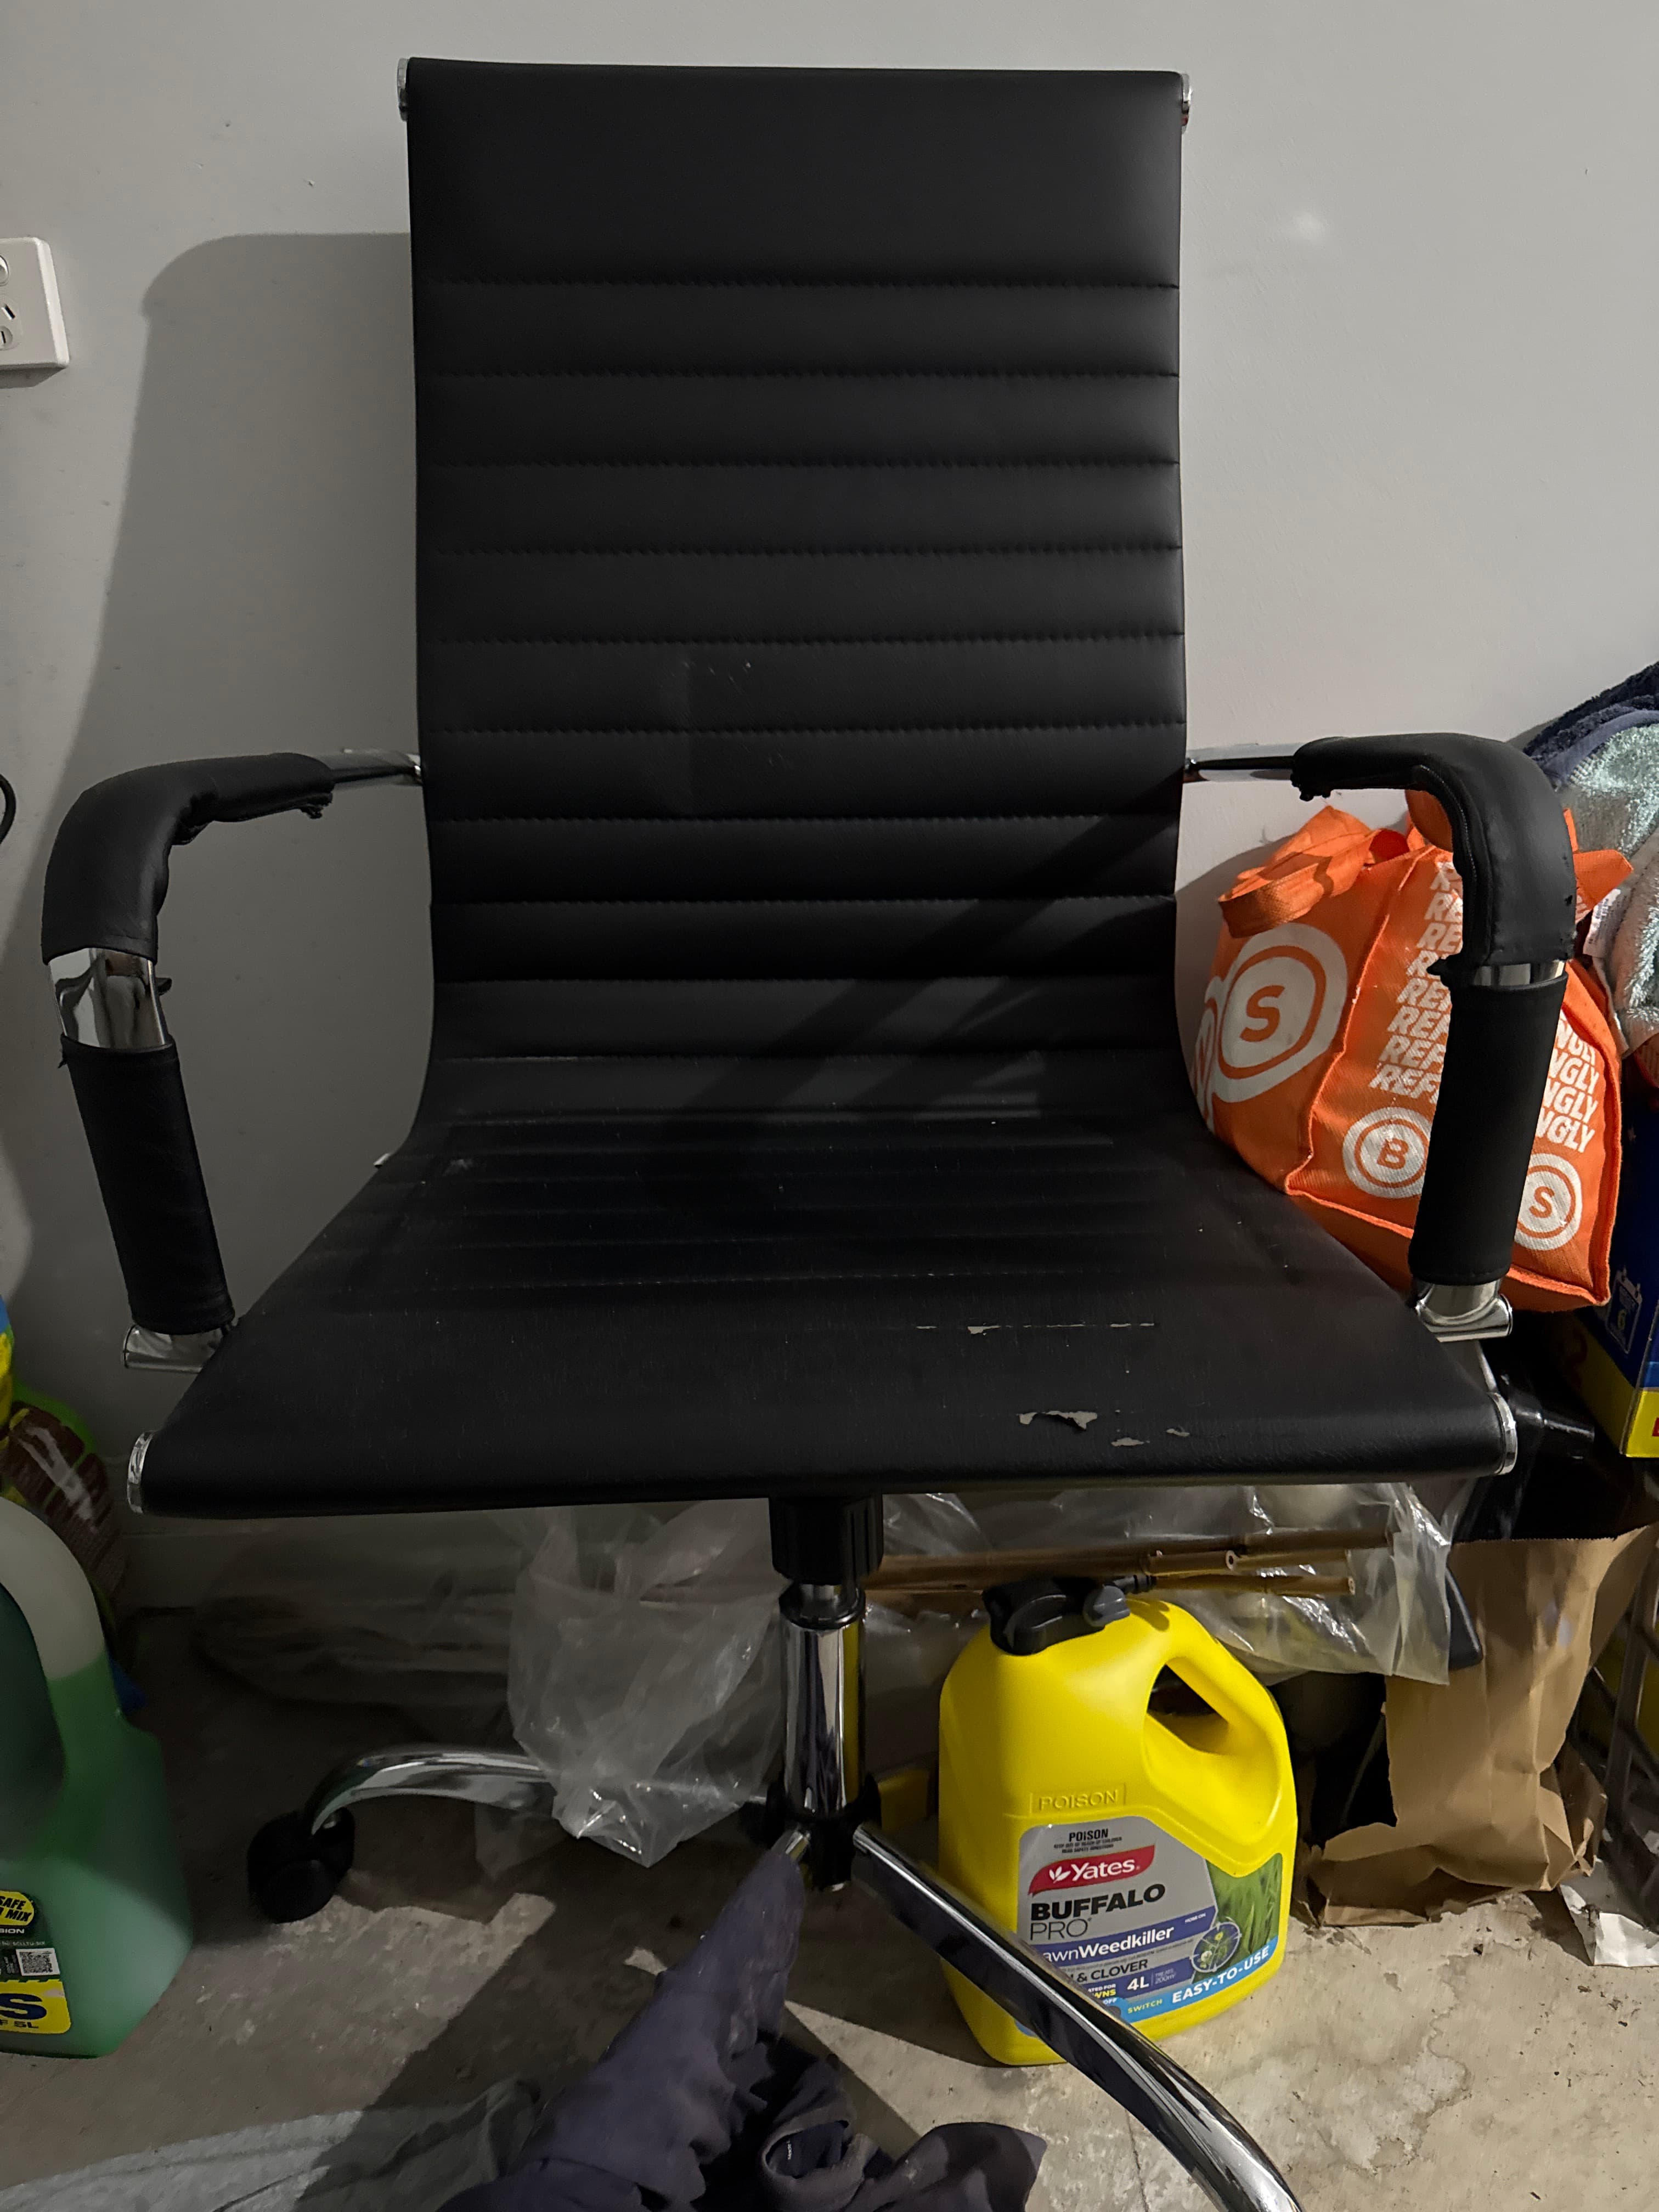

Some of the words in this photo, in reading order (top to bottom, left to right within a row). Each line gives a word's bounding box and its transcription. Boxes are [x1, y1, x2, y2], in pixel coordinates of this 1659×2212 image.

[1239, 985, 1285, 1042] S
[1039, 1789, 1118, 1810] POISON
[1069, 1829, 1109, 1842] POISON
[1071, 1859, 1135, 1881] Yates
[1031, 1883, 1166, 1920] BUFFALO
[5, 1909, 31, 1921] MIX
[1043, 1927, 1174, 1962] awnWeedkiller
[1077, 1973, 1087, 1982] &
[1091, 1959, 1148, 1980] CLOVER
[1172, 1945, 1269, 2004] EASY-TO-USE
[1127, 1976, 1149, 1990] 4L
[1127, 1999, 1163, 2013] SWITCH
